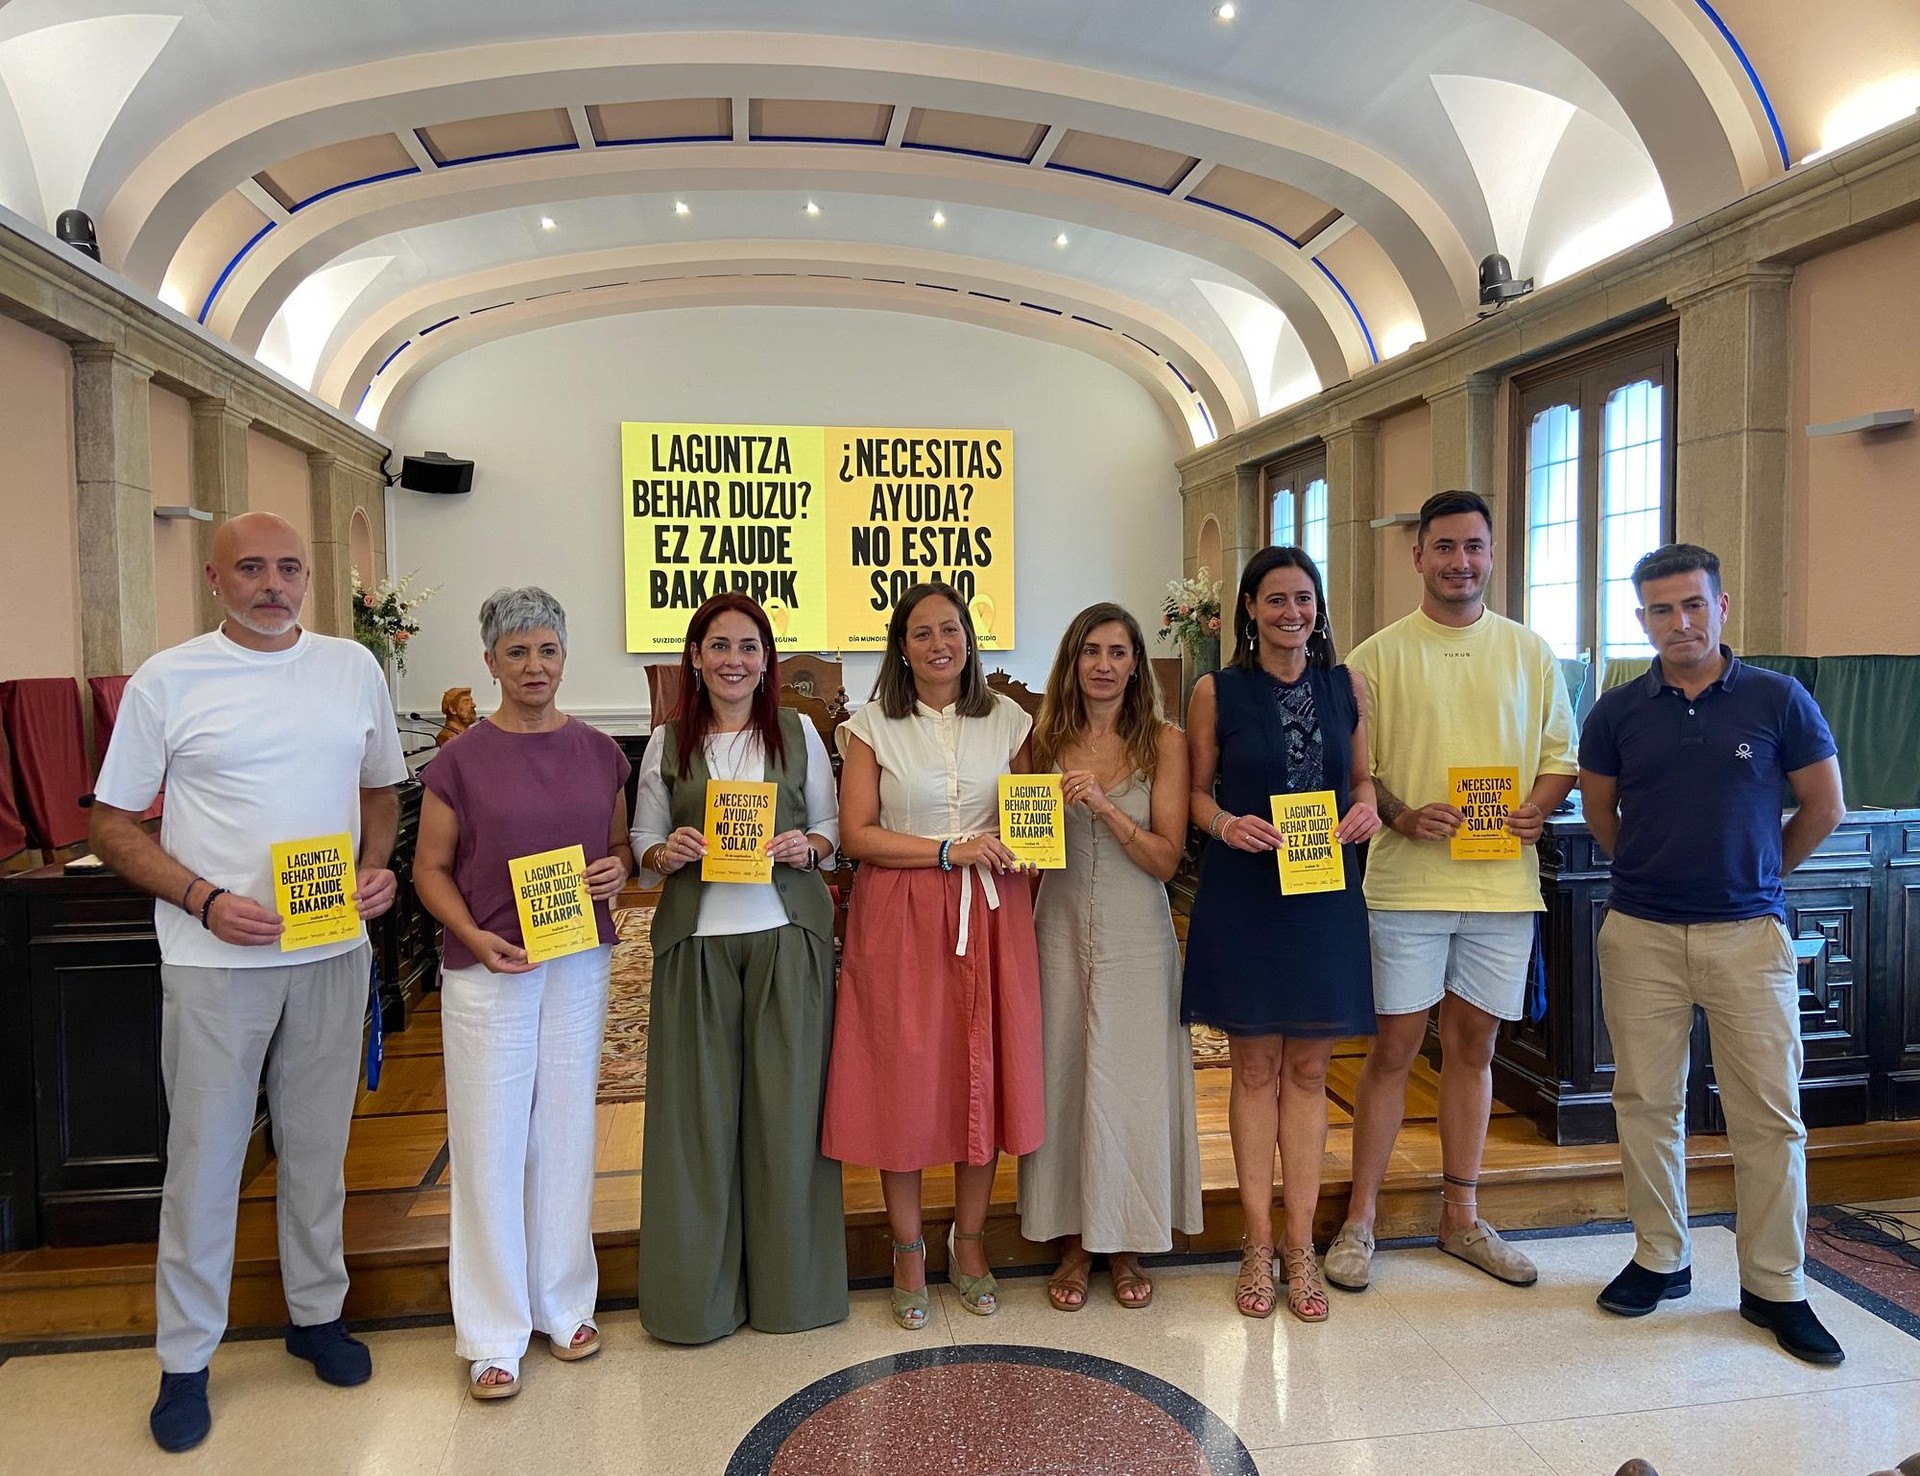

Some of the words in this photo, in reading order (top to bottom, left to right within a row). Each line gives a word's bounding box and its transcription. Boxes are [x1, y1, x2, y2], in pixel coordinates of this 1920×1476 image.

[651, 434, 792, 474] LAGUNTZA
[839, 438, 1002, 482] ¿NECESITAS
[633, 480, 720, 518] BEHAR
[729, 481, 812, 519] DUZU?
[870, 484, 974, 522] AYUDA?
[654, 525, 689, 564] EZ
[700, 525, 792, 564] ZAUDE
[852, 527, 890, 566] NO
[902, 526, 992, 567] ESTAS
[650, 570, 800, 609] BAKARRIK
[1010, 786, 1051, 798] LAGUNTZA
[1456, 778, 1512, 793] ¿NECESITAS
[713, 793, 769, 808] ¿NECESITAS
[1005, 800, 1030, 811] BEHAR
[1032, 800, 1057, 811] DUZU?
[1467, 792, 1502, 804] AYUDA?
[723, 808, 758, 822] AYUDA?
[1011, 813, 1021, 824] EZ
[1024, 813, 1052, 825] ZAUDE
[1284, 804, 1327, 819] LAGUNTZA
[1461, 806, 1474, 818] NO
[1478, 805, 1508, 817] ESTAS
[716, 822, 729, 835] NO
[733, 823, 764, 837] ESTAS
[1010, 826, 1054, 838] BAKARRIK
[1280, 820, 1307, 834] BEHAR
[1308, 818, 1333, 832] DUZU?
[1468, 818, 1503, 831] SOLA/O
[721, 837, 757, 851] SOLA/O
[1288, 835, 1299, 848] EZ
[1302, 832, 1330, 847] ZAUDE
[287, 848, 340, 868] LAGUNTZA
[1288, 846, 1333, 862] BAKARRIK
[281, 868, 315, 885] BEHAR
[318, 862, 348, 879] DUZU?
[524, 861, 573, 883] LAGUNTZA
[290, 885, 304, 900] EZ
[308, 878, 342, 896] ZAUDE
[520, 881, 552, 899] BEHAR
[554, 874, 581, 892] DUZU?
[290, 893, 346, 916] BAKARRIK
[530, 897, 544, 912] EZ
[546, 890, 578, 909] ZAUDE
[532, 903, 583, 928] BAKARRIK
